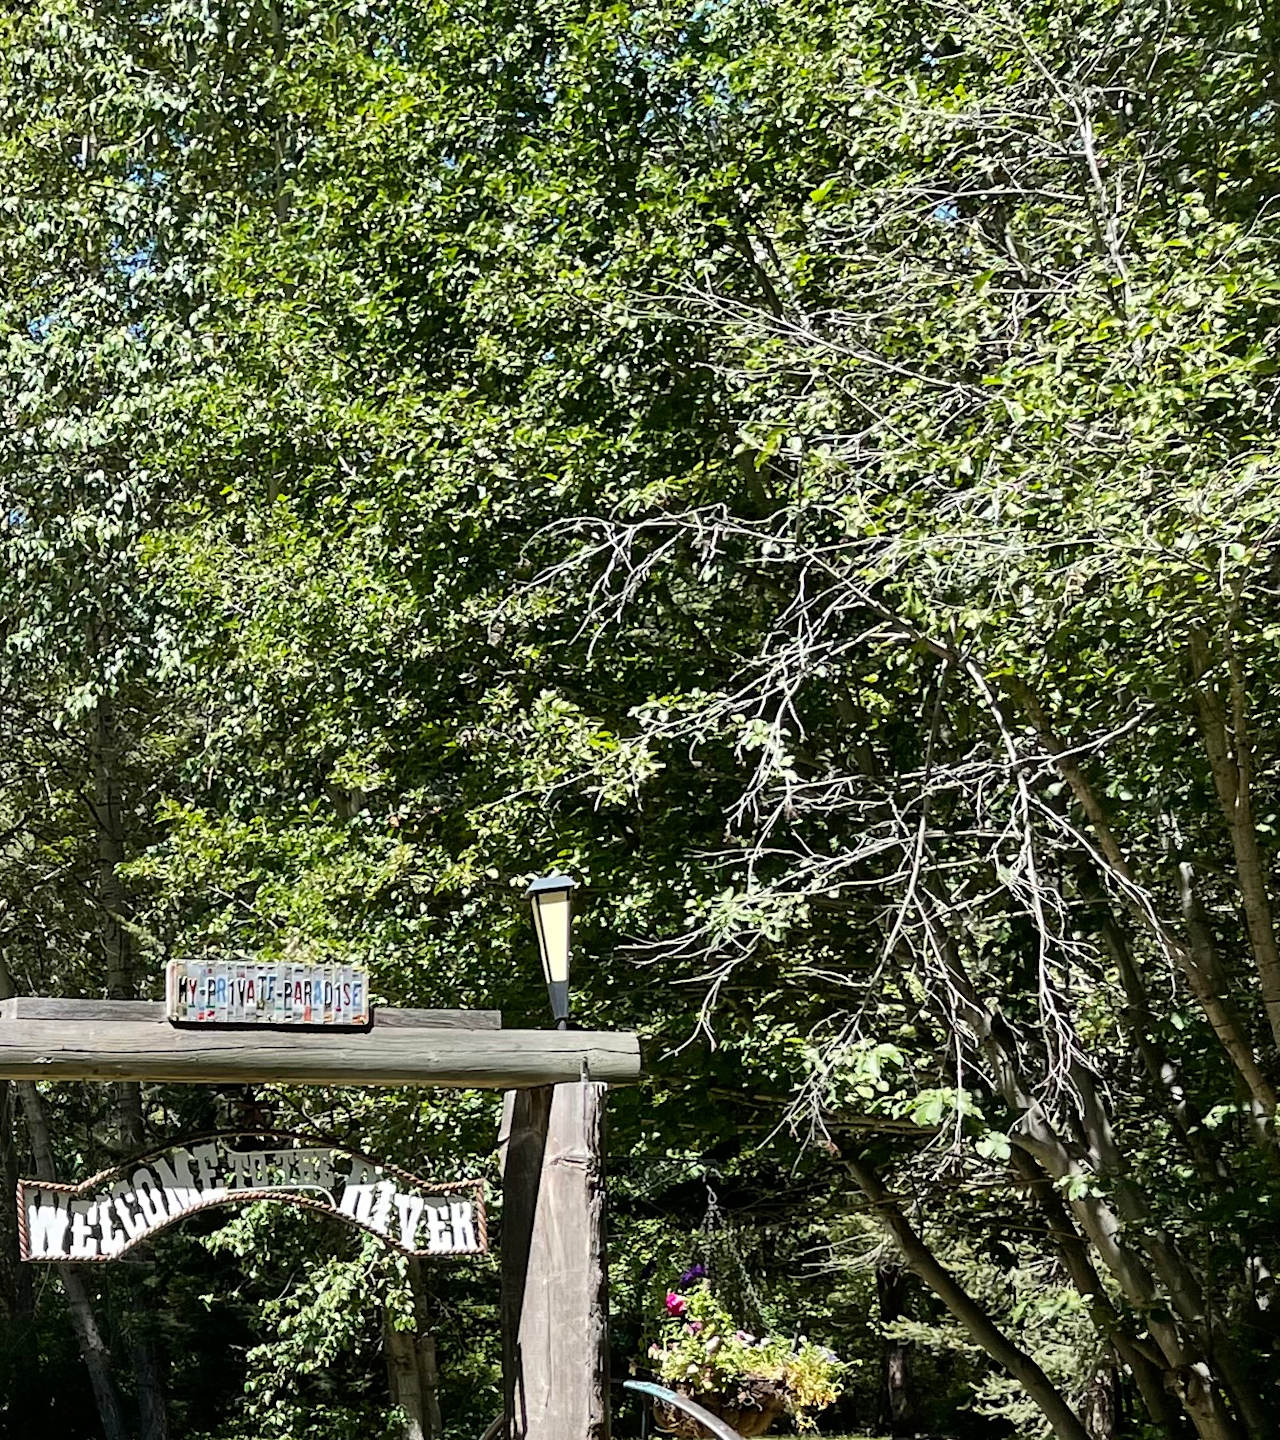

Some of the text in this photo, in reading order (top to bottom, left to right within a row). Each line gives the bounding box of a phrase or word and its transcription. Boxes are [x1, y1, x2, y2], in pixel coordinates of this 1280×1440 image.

[24, 1142, 480, 1257] WELCOME TO THE RIVER
